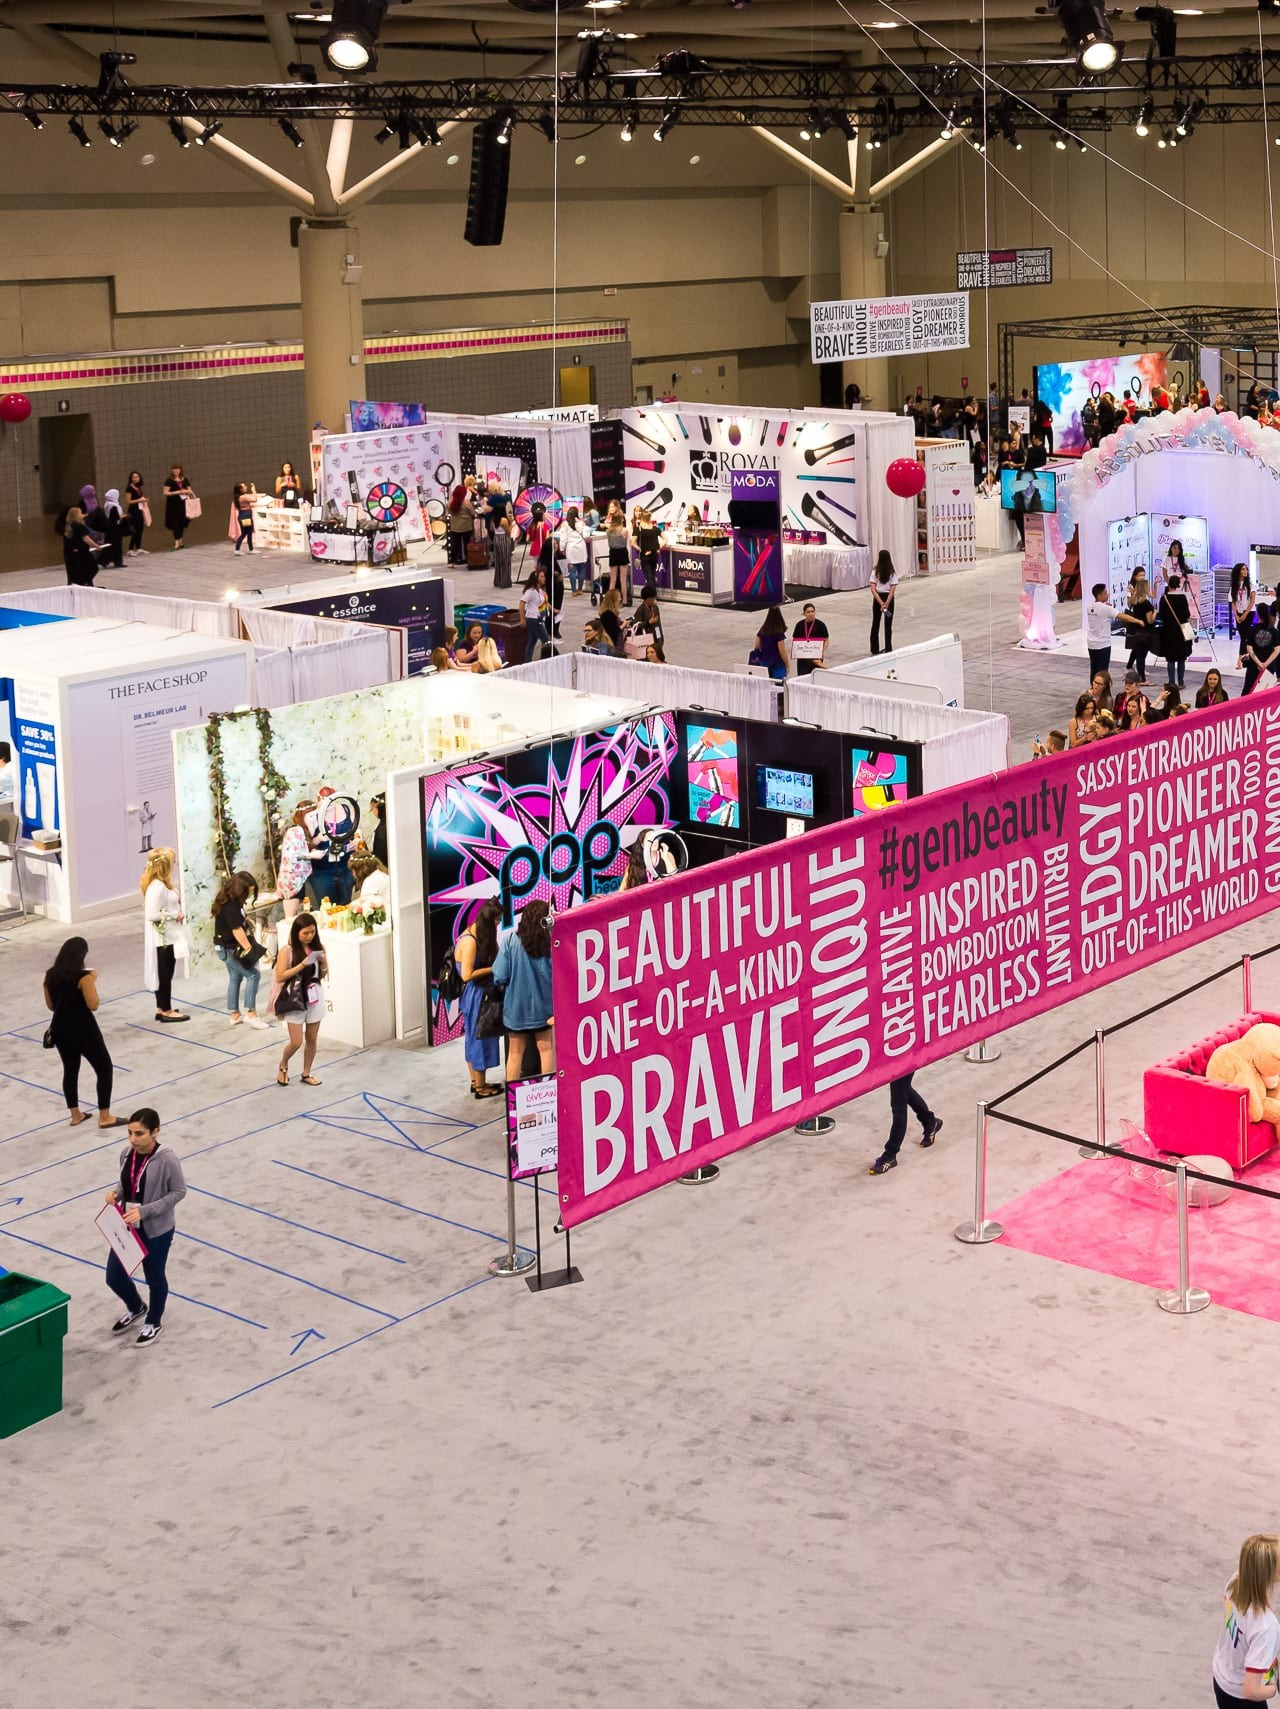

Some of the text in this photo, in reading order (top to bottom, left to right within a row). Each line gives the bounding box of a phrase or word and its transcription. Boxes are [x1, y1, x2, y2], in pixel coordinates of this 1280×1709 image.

[958, 271, 982, 288] BRAVE
[814, 305, 854, 321] BEAUTIFUL
[855, 304, 868, 354] UNIQUE
[869, 301, 910, 318] #genbeauty
[877, 318, 904, 331] INSPIRED
[913, 309, 923, 340] EDGY
[923, 308, 953, 322] PIONEER
[924, 321, 957, 337] DREAMER
[815, 333, 854, 359] BRAVE
[878, 339, 904, 352] FEARLESS
[537, 410, 596, 422] TIMATE
[733, 473, 776, 487] MODA
[678, 559, 704, 571] MODA
[333, 604, 376, 617] essence
[108, 670, 208, 700] THE FACE SHOP
[20, 725, 40, 739] SAVE
[133, 704, 187, 721] DR. BELMEUR LAB
[1076, 708, 1266, 798] SASSY EXTRAORDINARY
[1243, 750, 1261, 805] COOL
[1128, 758, 1241, 845] PIONEER
[878, 779, 1069, 892] #genbeauty
[1129, 808, 1259, 910] DREAMER
[499, 819, 621, 931] pop
[1079, 800, 1123, 936] EDGY
[919, 856, 1038, 945] INSPIRED
[1043, 843, 1072, 988] BRILLIANT
[1080, 869, 1259, 975] OUT-OF-THIS-WORLD
[576, 862, 802, 1005] BEAUTIFUL
[921, 909, 1040, 987] BOMBDOTCOM
[808, 836, 870, 1094] UNIQUE
[880, 899, 917, 1057] CREATIVE
[576, 940, 803, 1066] ONE-OF-A-KIND
[922, 950, 1041, 1044] FEARLESS
[580, 996, 802, 1197] BRAVE
